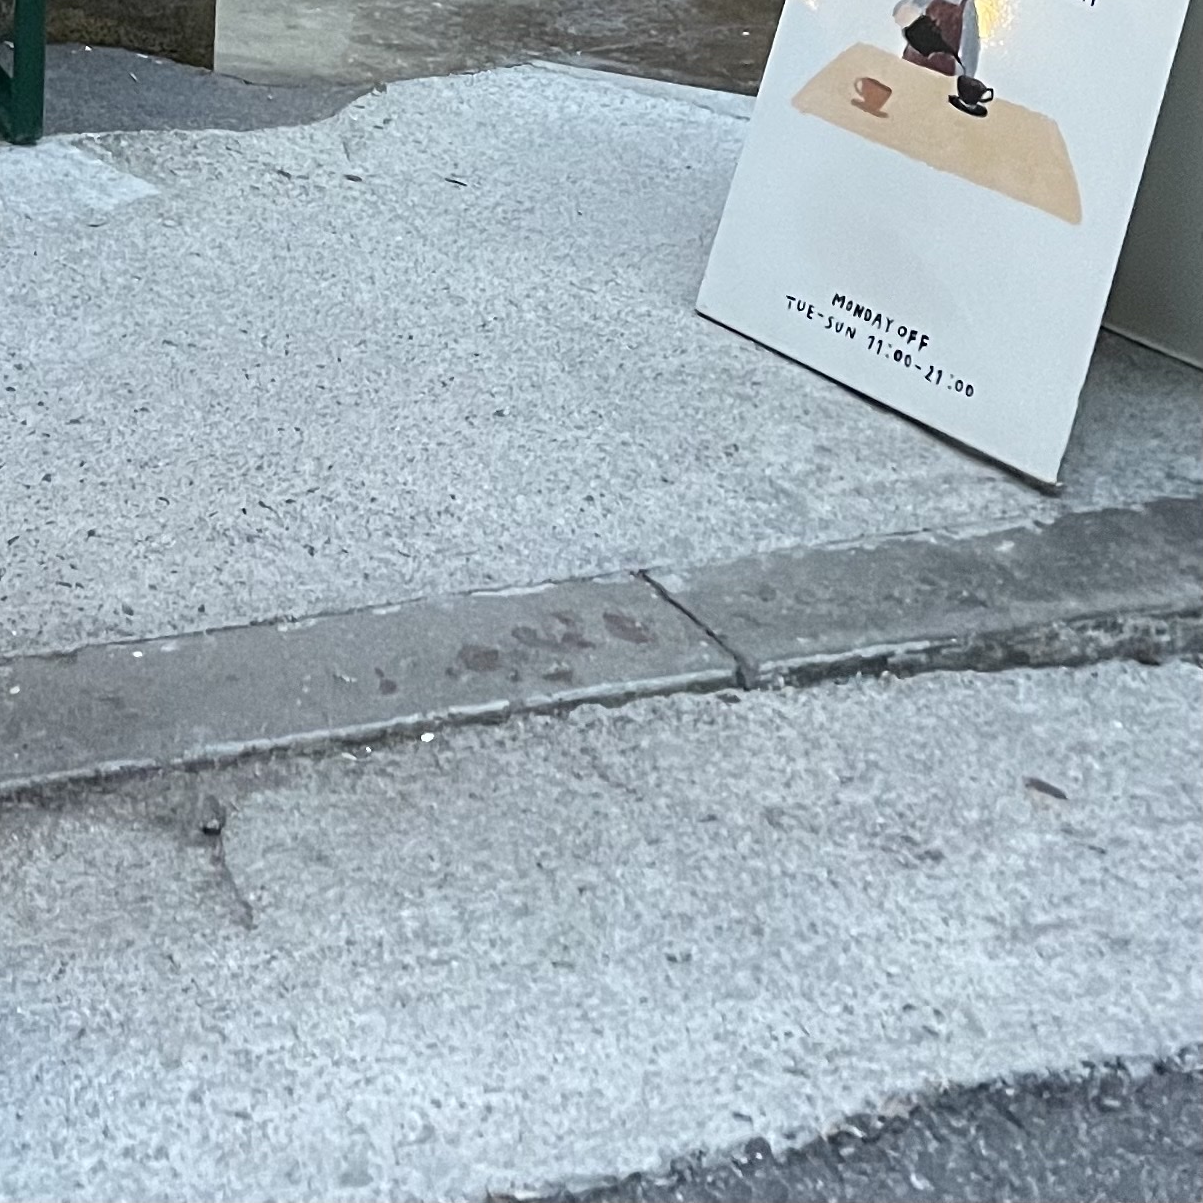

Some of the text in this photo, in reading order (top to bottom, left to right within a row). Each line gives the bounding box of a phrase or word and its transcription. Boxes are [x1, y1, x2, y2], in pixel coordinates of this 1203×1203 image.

[785, 294, 856, 339] TUE-SUN
[831, 292, 930, 351] MONDAY OFF
